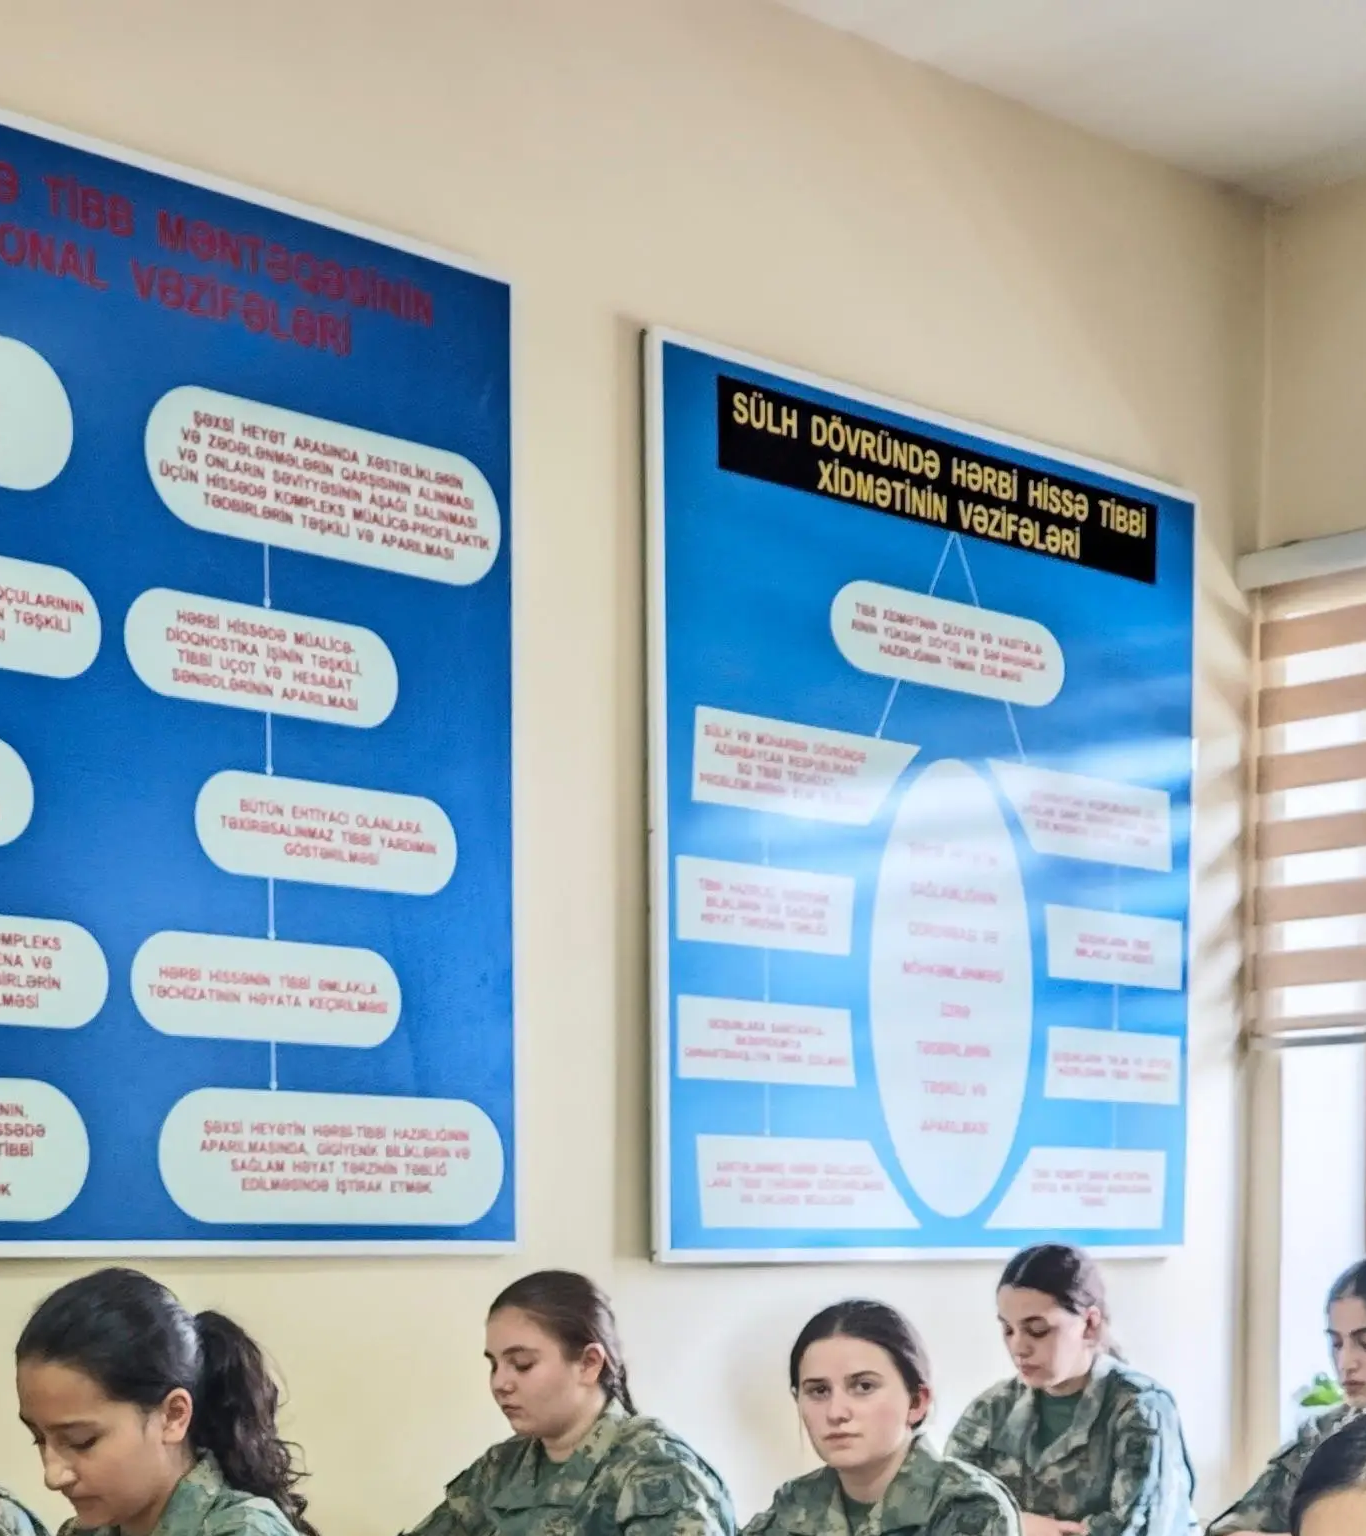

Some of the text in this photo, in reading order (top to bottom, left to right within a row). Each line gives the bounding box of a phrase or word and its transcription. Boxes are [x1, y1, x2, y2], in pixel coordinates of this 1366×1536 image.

[43, 175, 134, 237] TİBB
[156, 208, 433, 328] MƏNTƏQƏSİNİN
[130, 256, 352, 358] VƏZİFƏLƏRİ
[732, 391, 1147, 539] SÜLH DÖVRÜNDƏ HƏRBİ HİSSƏ TİBBİ
[817, 459, 1081, 559] XİDMƏTİNİN VƏZİFƏLƏRİ
[14, 610, 71, 632] TƏŞKİLİ
[31, 955, 52, 969] VƏ
